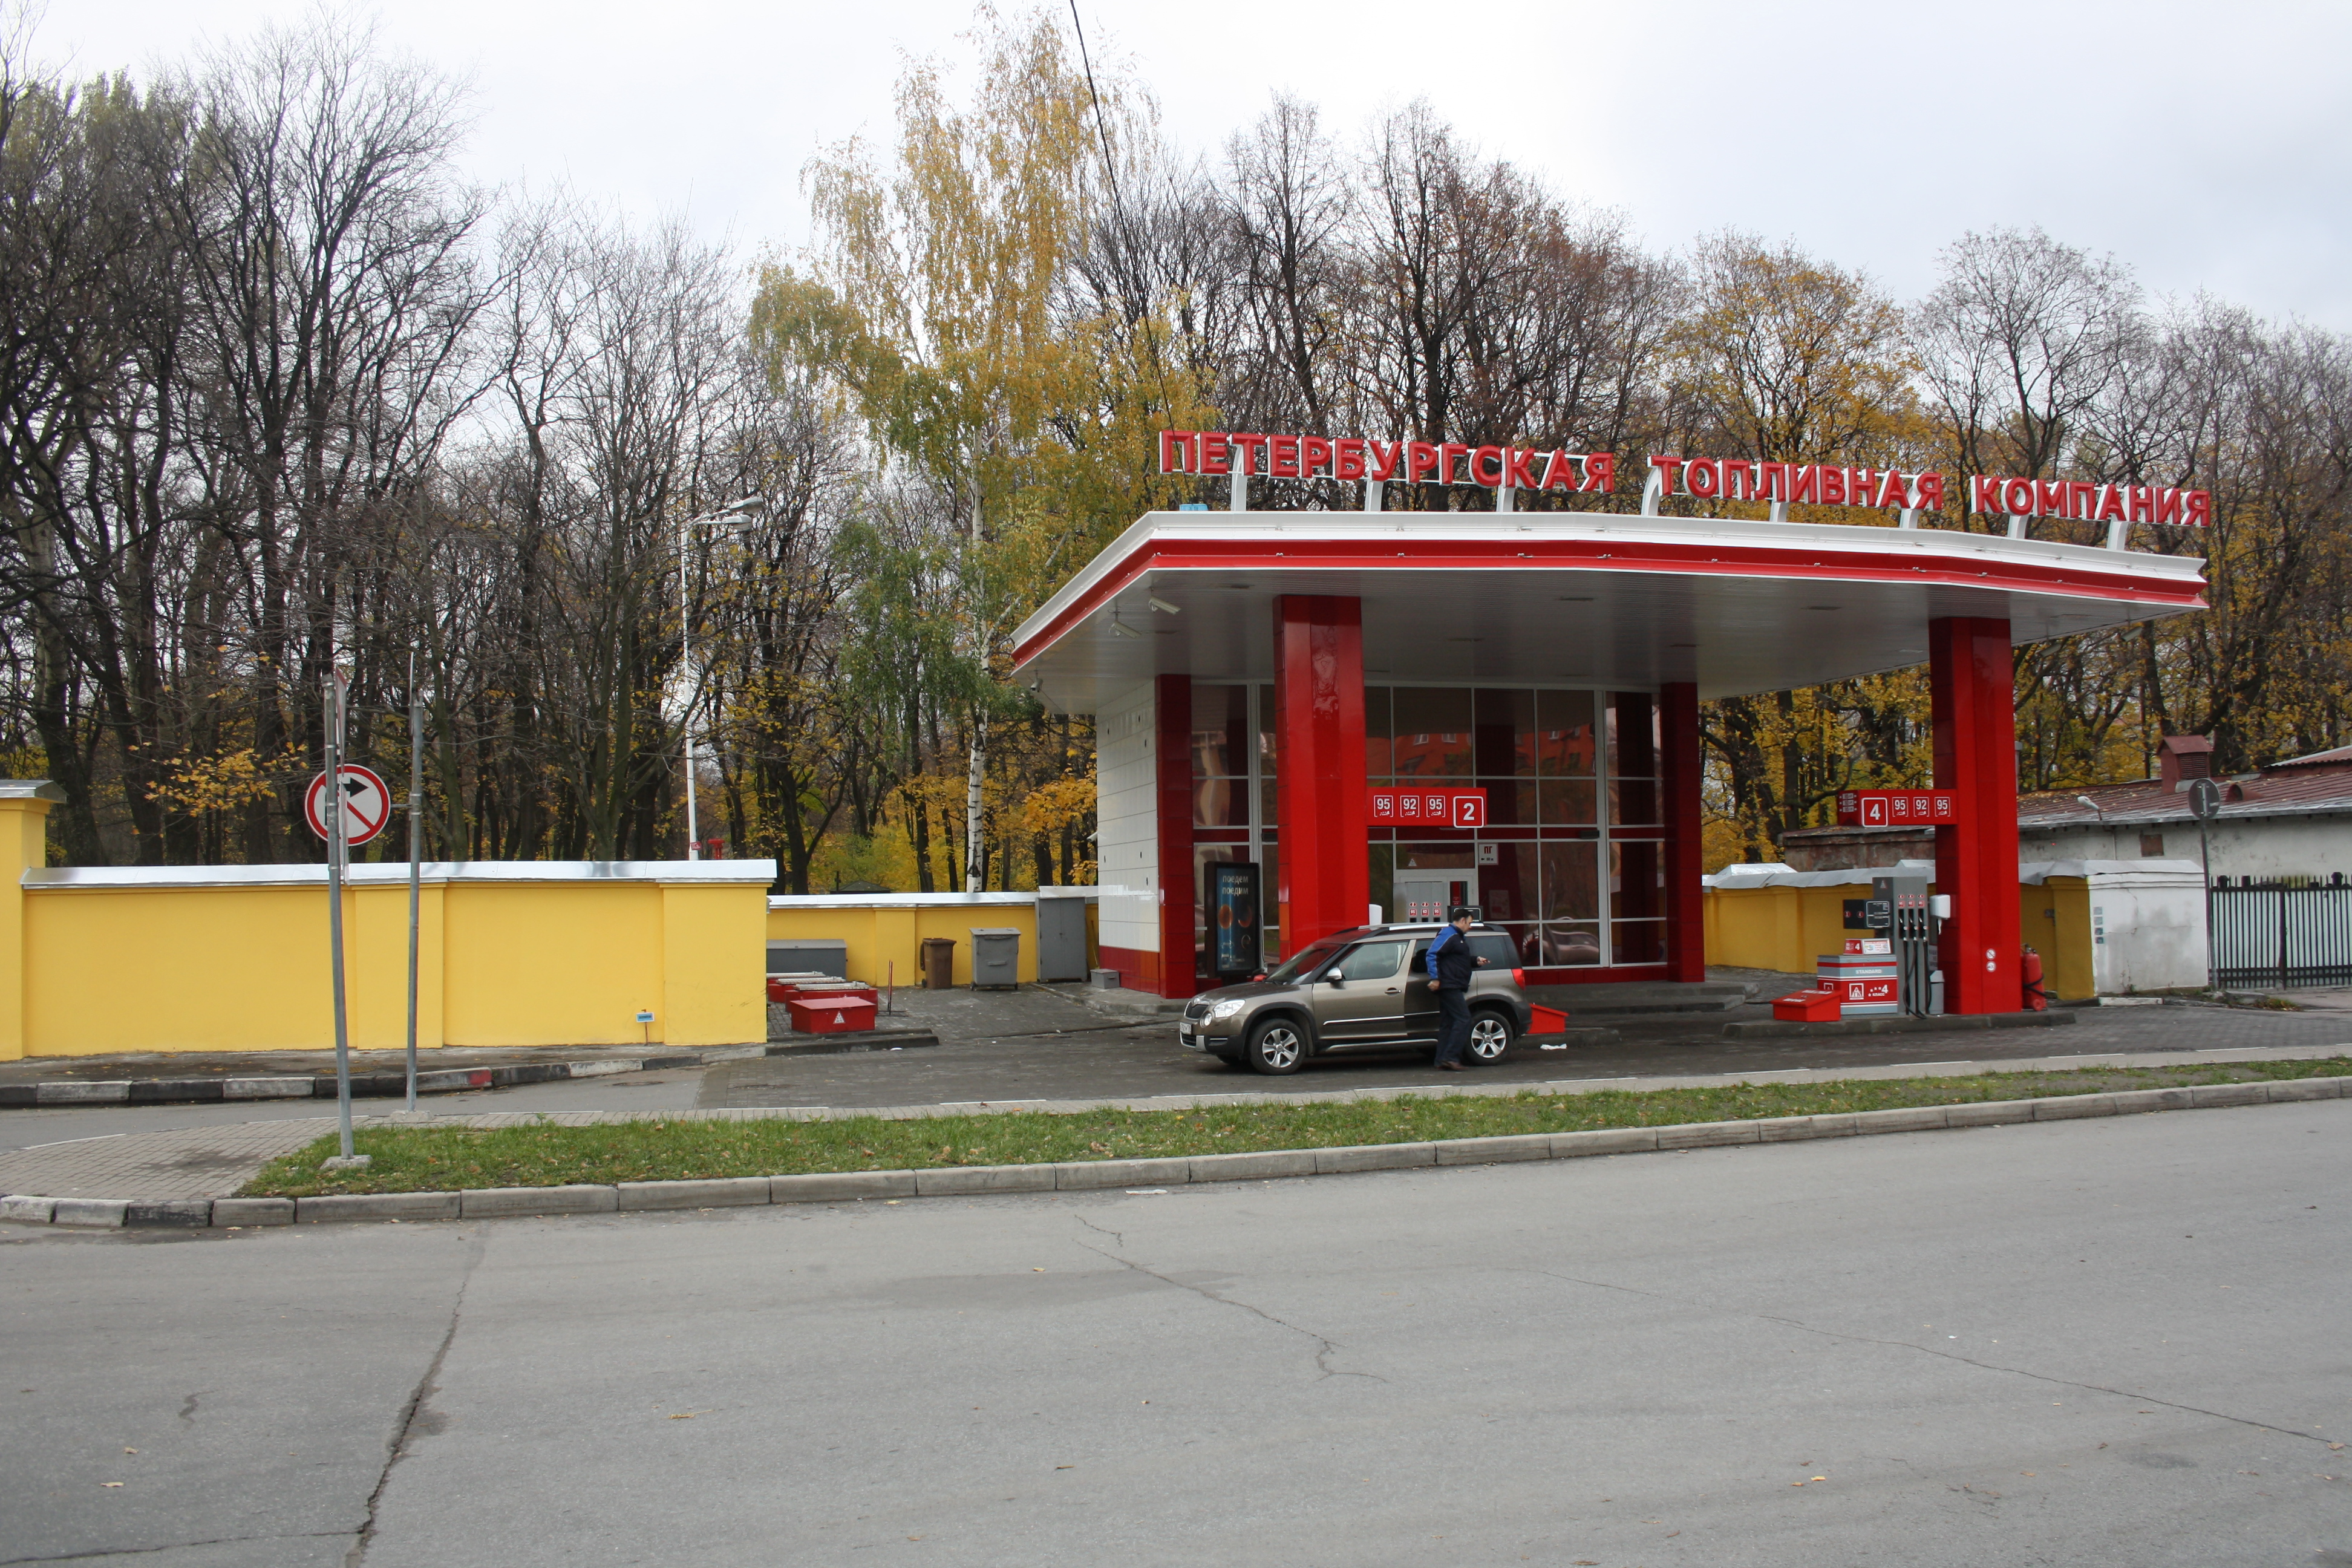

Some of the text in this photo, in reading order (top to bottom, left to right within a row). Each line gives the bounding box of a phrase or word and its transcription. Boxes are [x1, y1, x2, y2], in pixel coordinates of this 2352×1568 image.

[1159, 430, 2210, 526] ПЕТЕРБУРГСКАЯ ТОПЛИВНАЯ КОМПАНИЯ
[1377, 798, 1442, 810] 95 92 95
[1894, 799, 1948, 810] 95 92 95
[1463, 802, 1475, 821] 2
[1869, 803, 1881, 820] 4
[1223, 875, 1249, 885] поедем
[1222, 887, 1249, 897] поедим
[1881, 984, 1889, 994] 4
